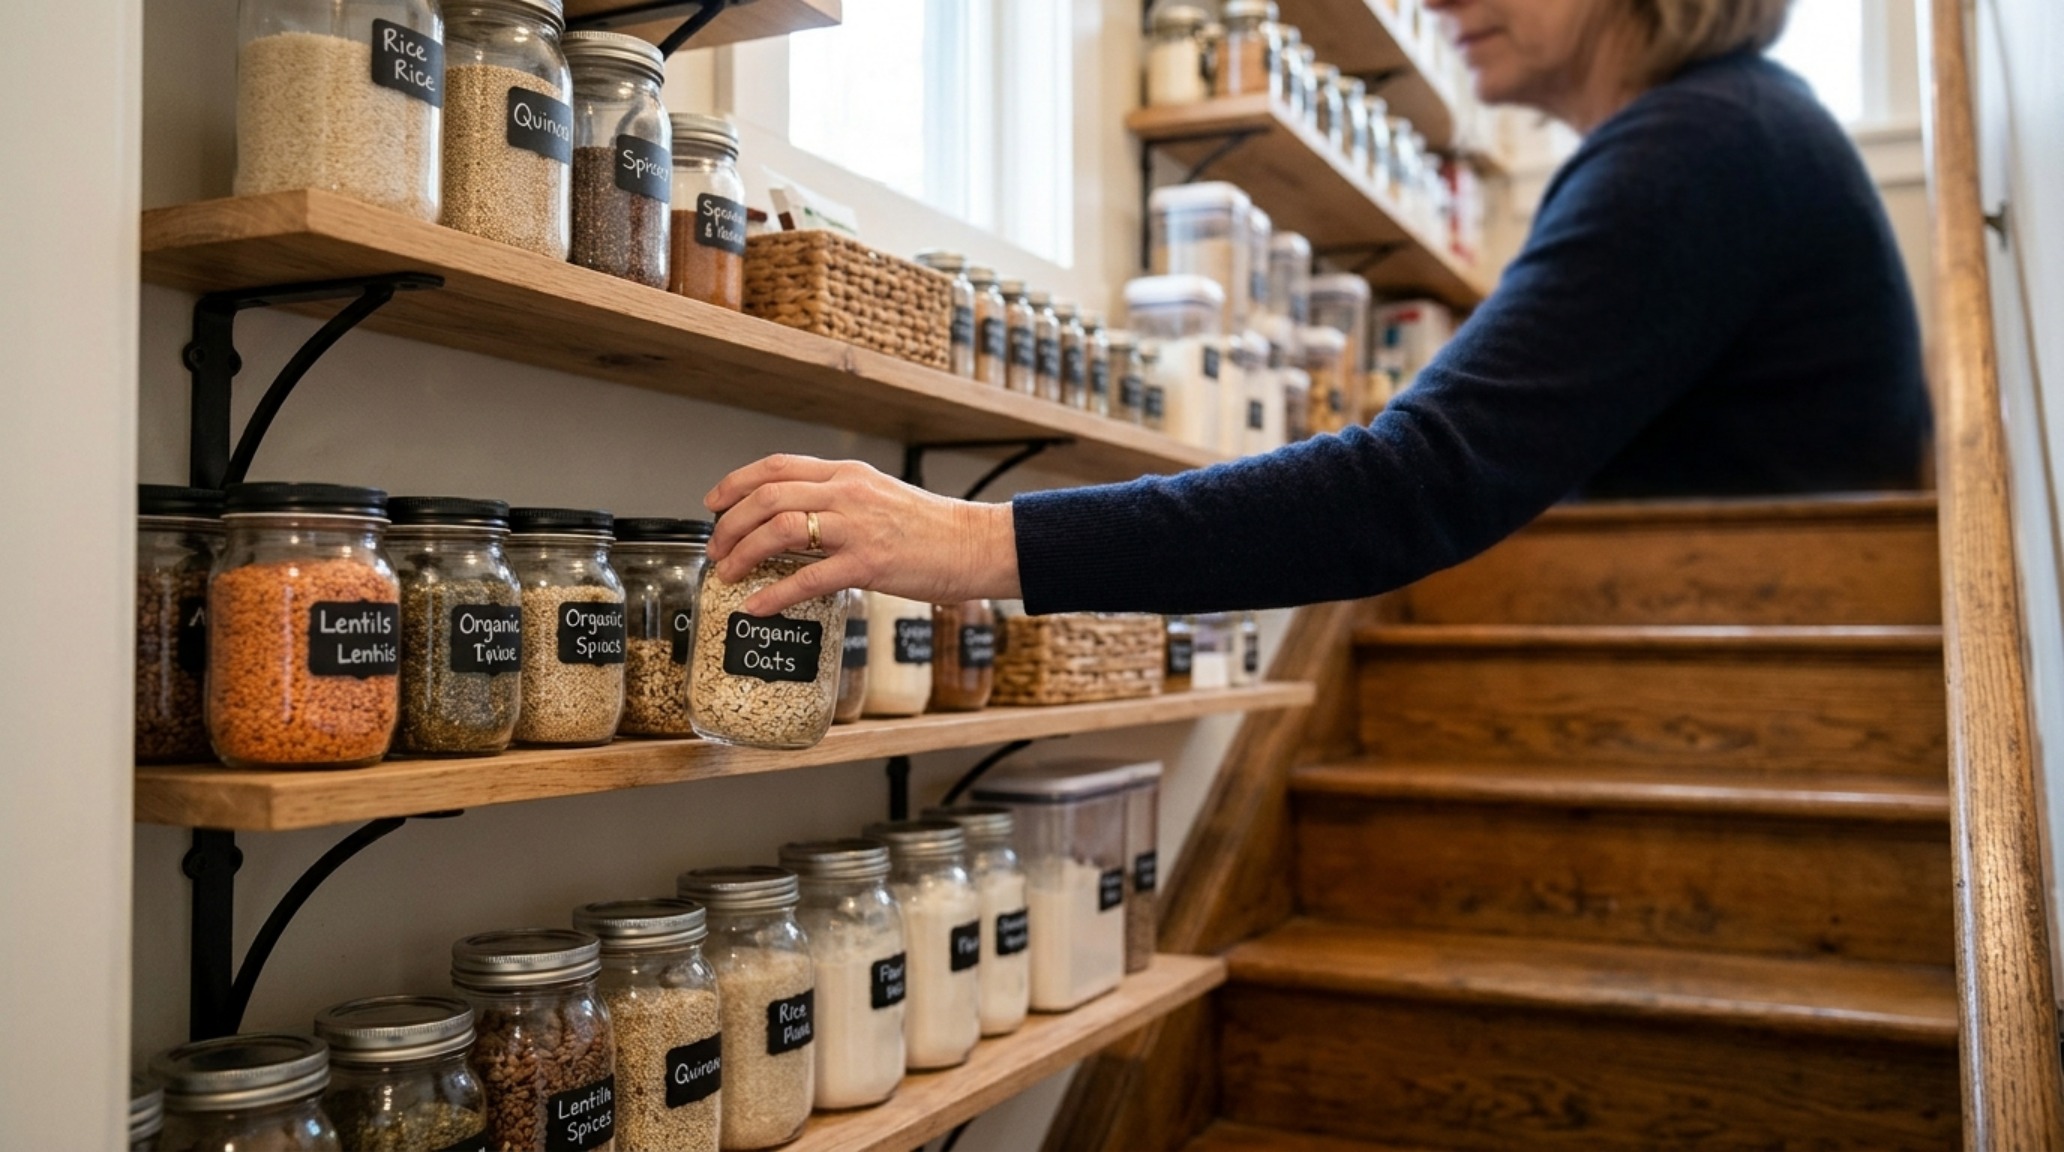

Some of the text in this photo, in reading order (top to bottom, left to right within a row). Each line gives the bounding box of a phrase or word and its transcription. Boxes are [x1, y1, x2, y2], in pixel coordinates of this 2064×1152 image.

[383, 27, 428, 62] Rice
[394, 58, 436, 92] Rice
[320, 609, 392, 634] Lentils
[460, 612, 520, 643] Organic
[735, 619, 813, 649] Organic
[743, 649, 796, 673] Oats
[567, 1109, 612, 1145] Spices
